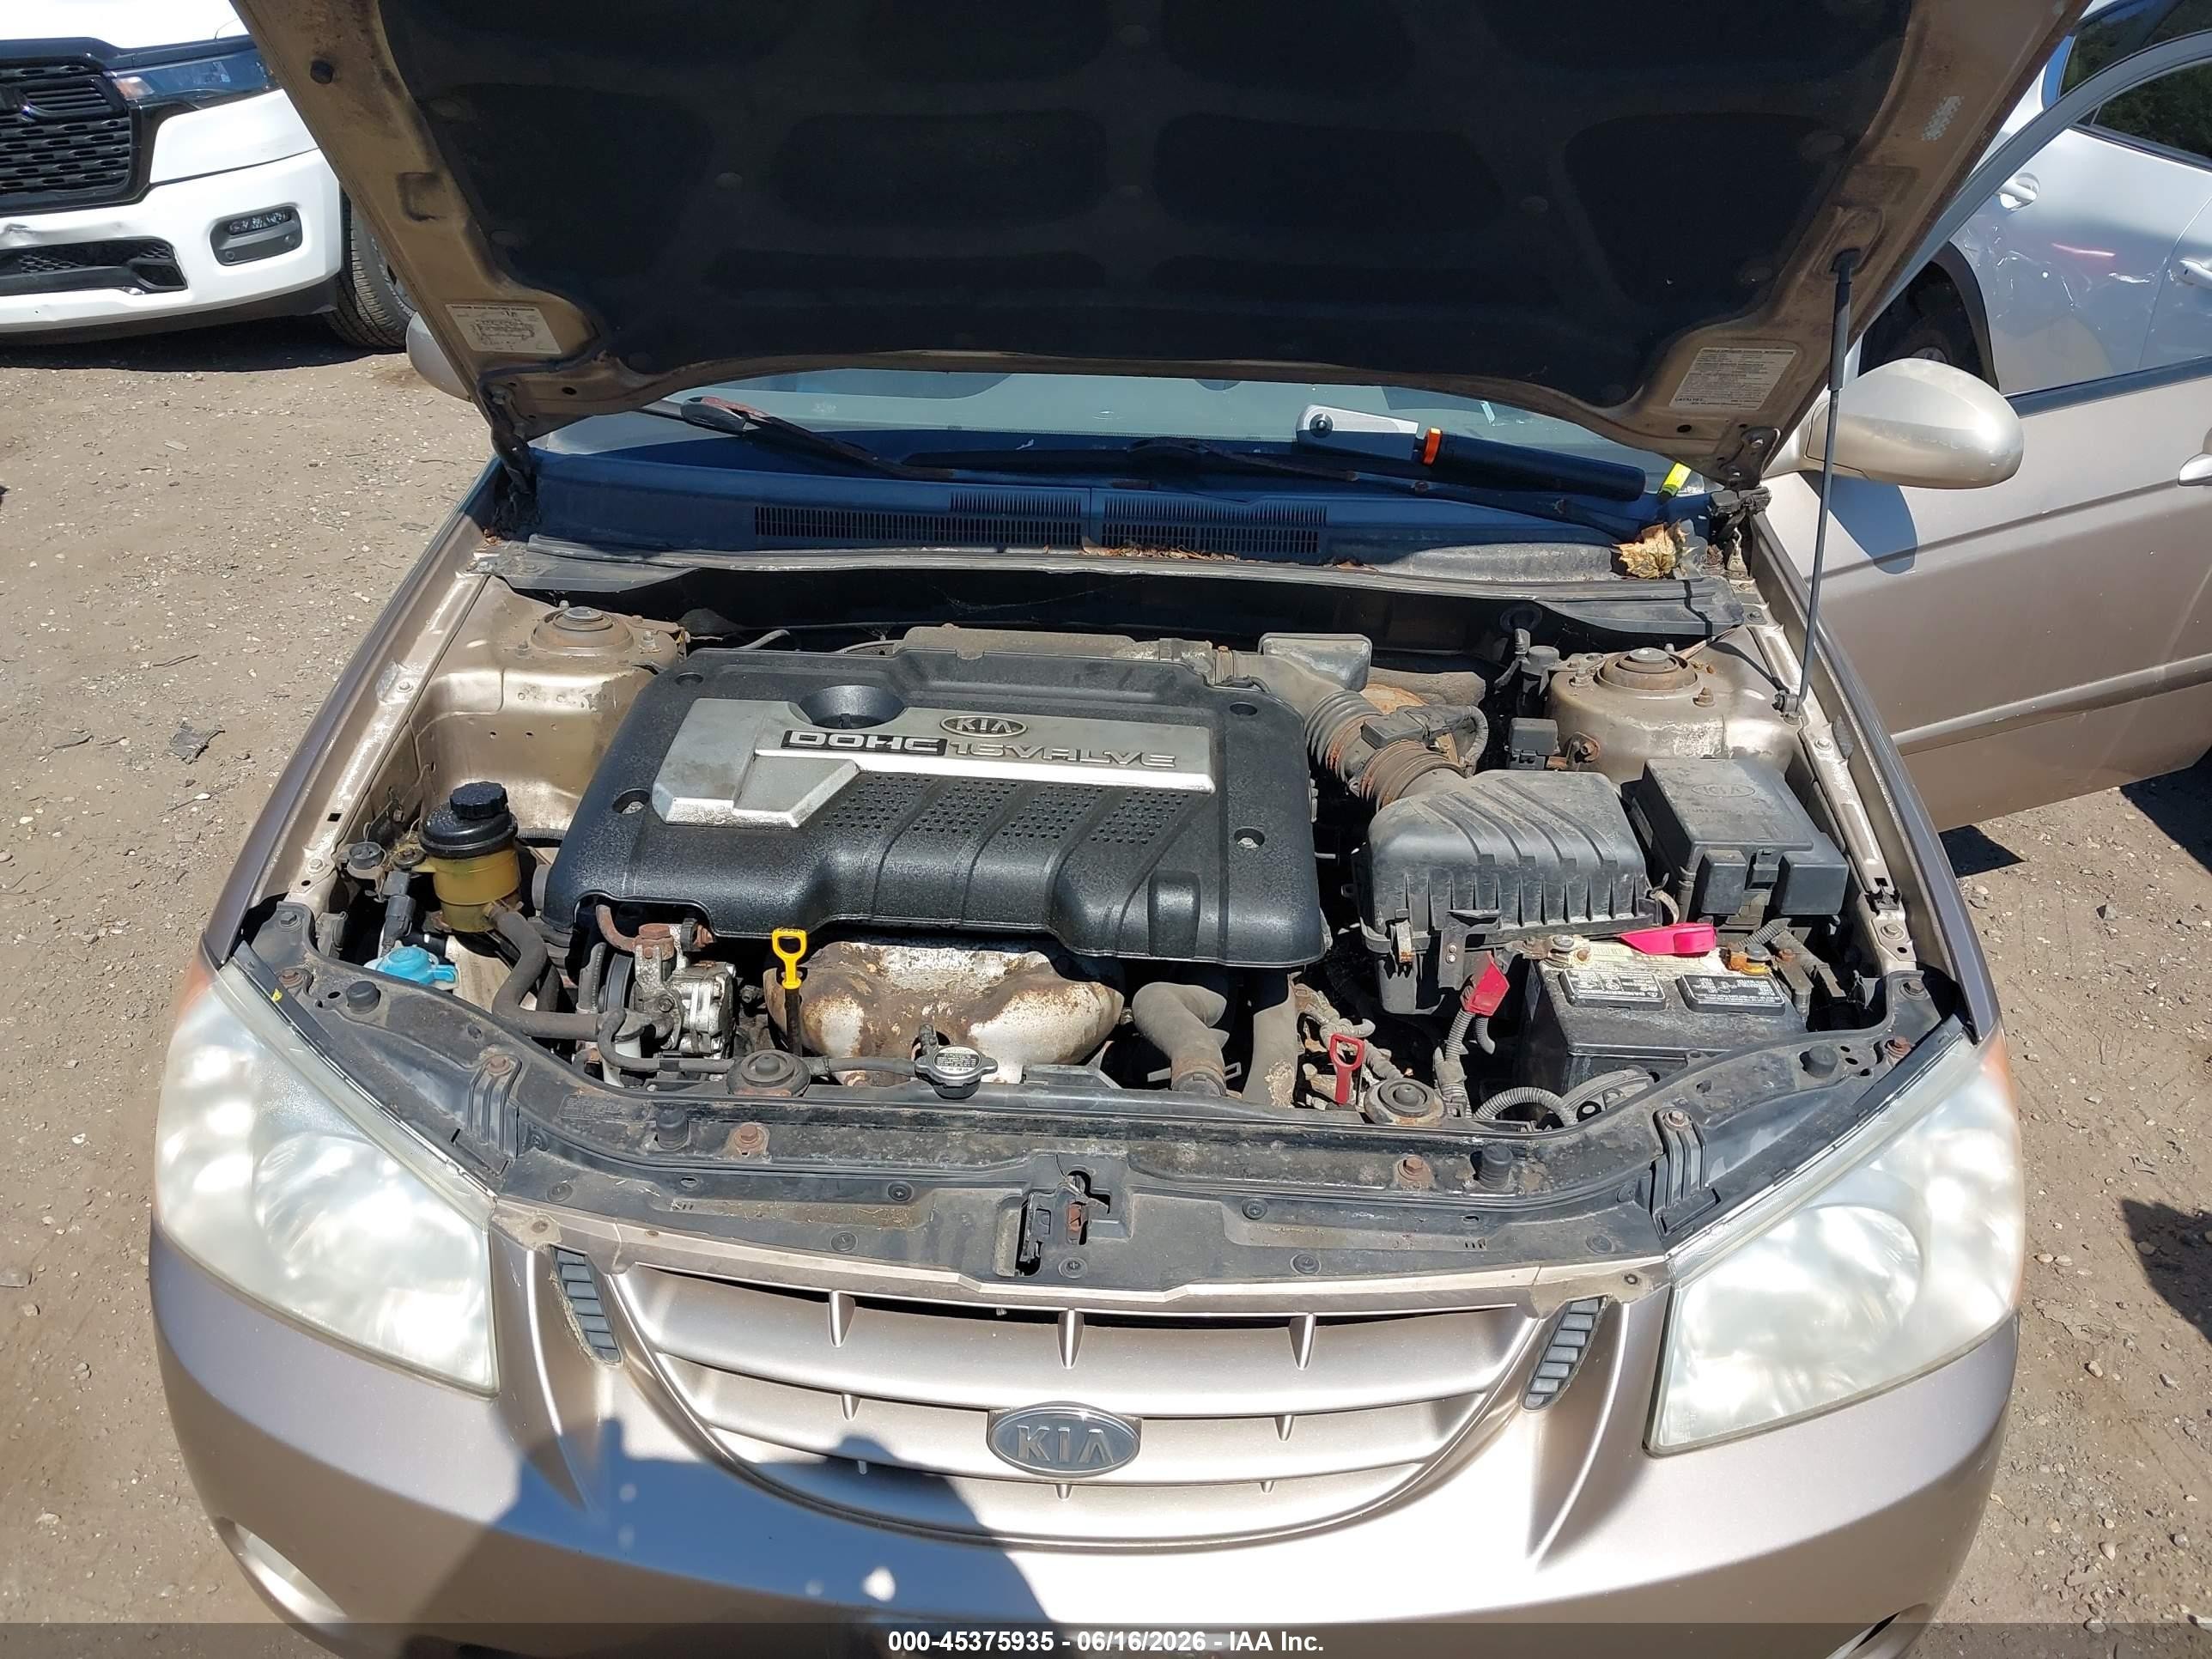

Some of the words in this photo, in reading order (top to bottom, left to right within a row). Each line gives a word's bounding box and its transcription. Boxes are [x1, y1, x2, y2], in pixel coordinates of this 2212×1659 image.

[957, 717, 1016, 734] KIA
[788, 731, 941, 753] DOHC
[948, 740, 1176, 769] 16VALVE
[1017, 1425, 1115, 1464] KIA
